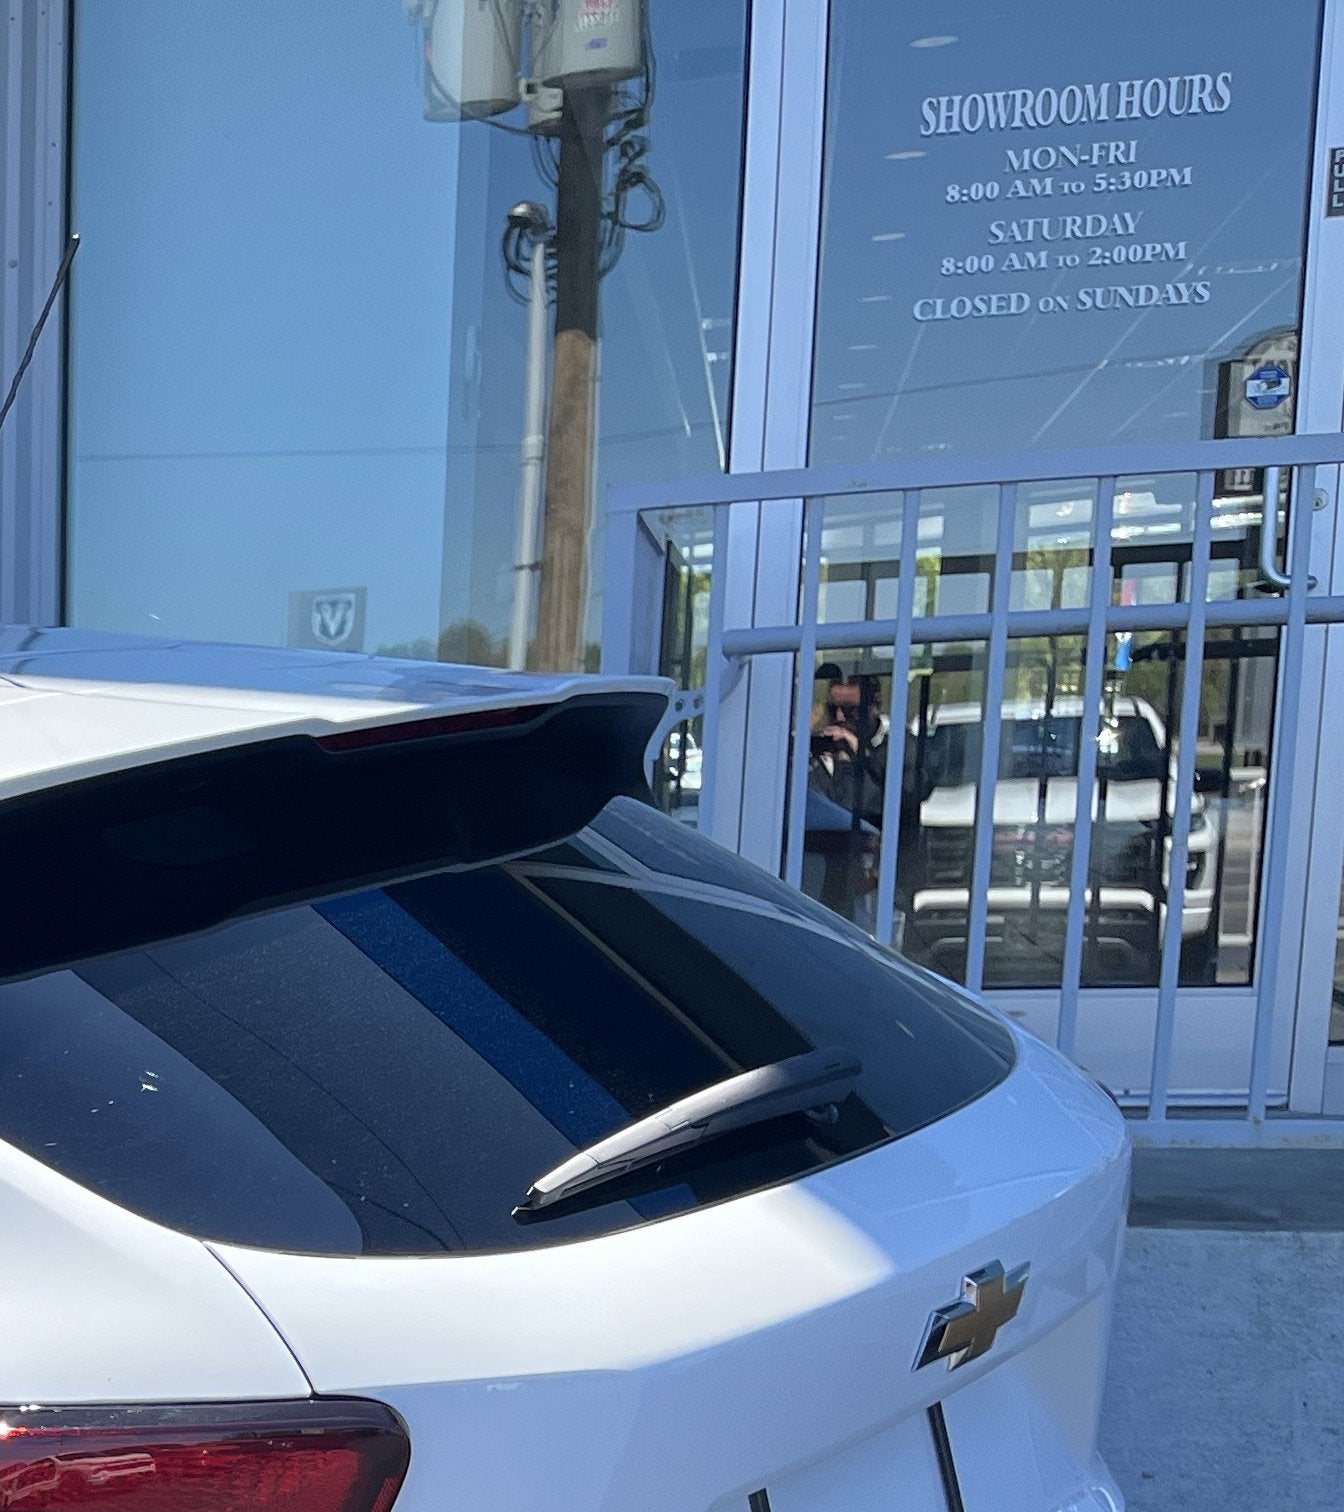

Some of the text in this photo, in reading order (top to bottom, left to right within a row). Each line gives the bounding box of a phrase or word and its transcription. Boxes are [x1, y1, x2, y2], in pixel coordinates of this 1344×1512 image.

[920, 72, 1232, 137] SHOWROOM HOURS
[1003, 140, 1138, 173] MON-FRI
[945, 181, 1001, 203] 8:00
[1005, 177, 1054, 199] AM
[1092, 166, 1193, 193] 5:30PM
[1332, 149, 1344, 208] PULL
[988, 210, 1144, 245] SATURDAY
[940, 254, 996, 276] 8:00
[1000, 250, 1049, 272] AM
[1087, 240, 1189, 266] 2:00PM
[913, 292, 1031, 322] CLOSED
[1076, 280, 1212, 311] SUNDAYS
